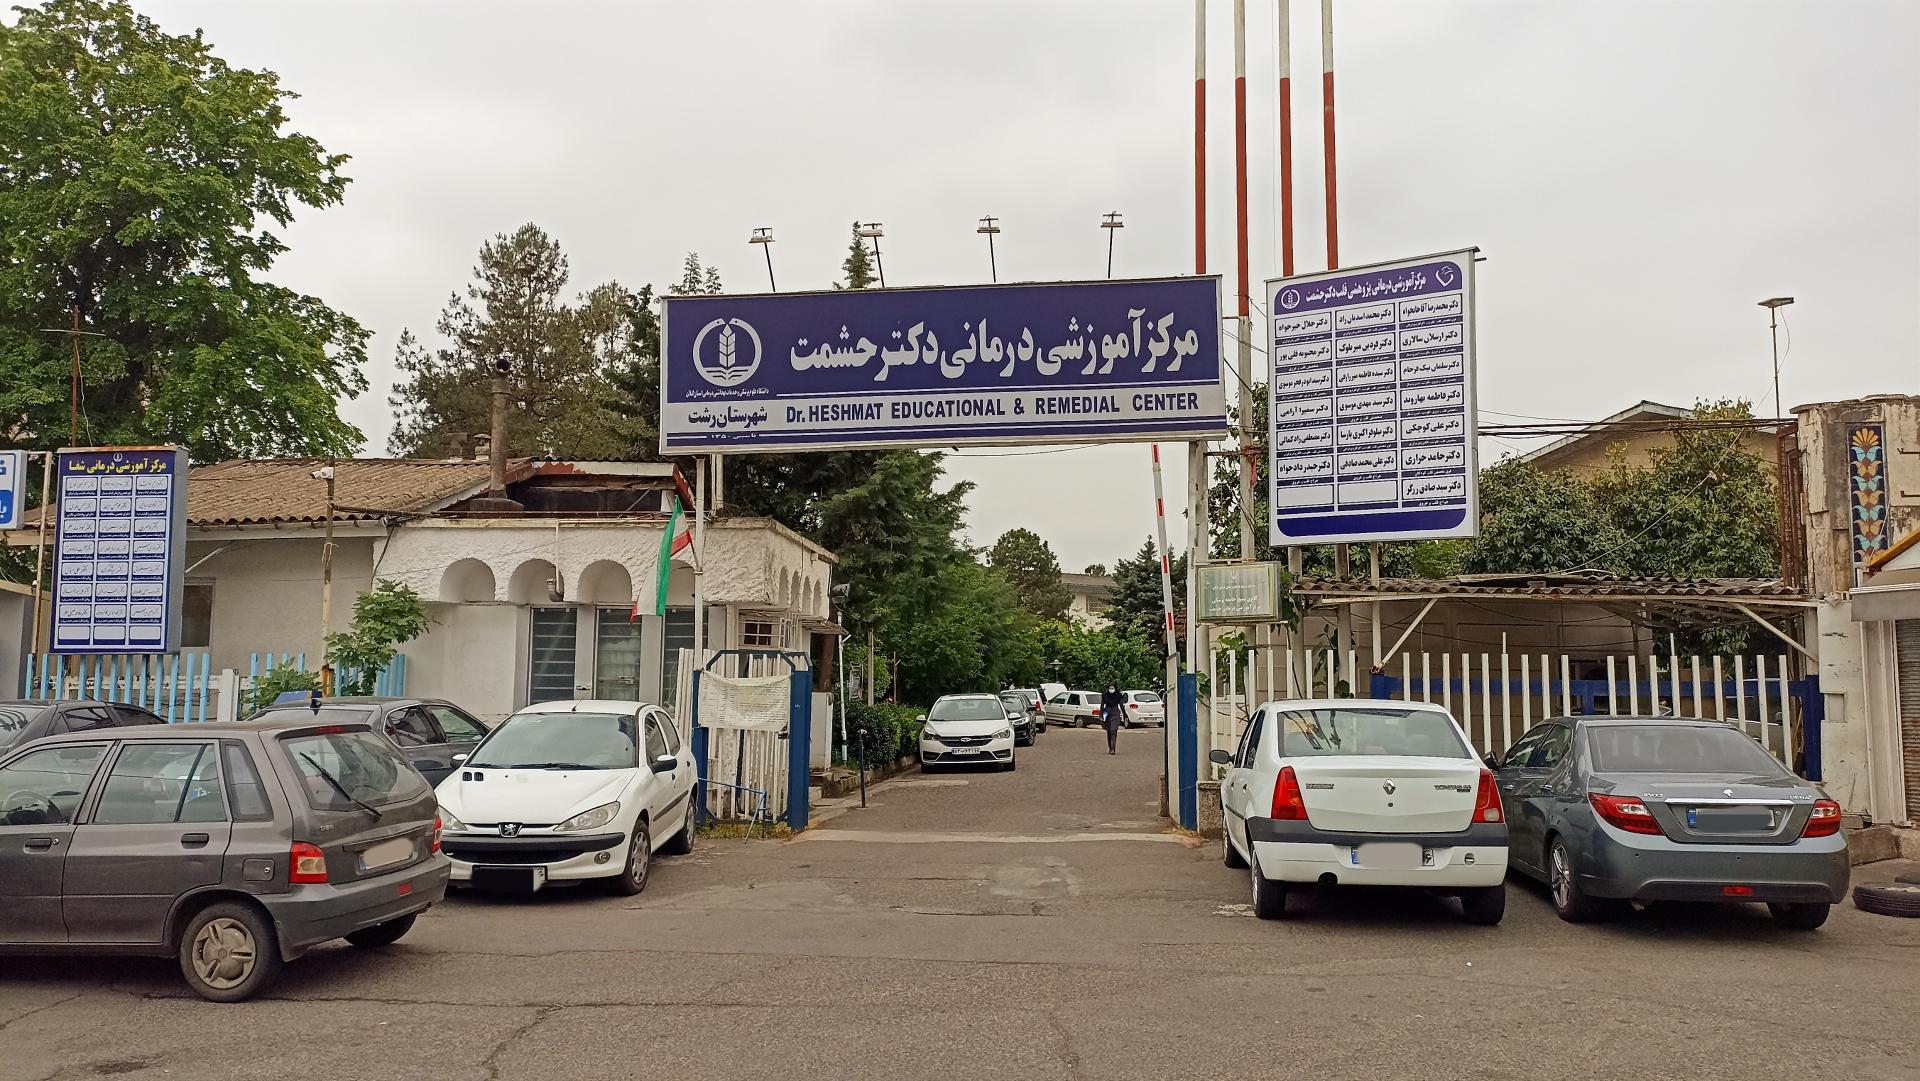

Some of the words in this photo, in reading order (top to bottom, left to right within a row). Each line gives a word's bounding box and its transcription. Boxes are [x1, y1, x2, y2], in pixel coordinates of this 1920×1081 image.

[790, 324, 878, 370] حشمت
[874, 321, 938, 382] دکتر
[940, 318, 1034, 379] درمانی
[1036, 308, 1146, 376] آموزشی
[1141, 312, 1198, 373] مرکز
[688, 407, 716, 428] رشت
[716, 406, 768, 428] شهرستان
[786, 406, 806, 423] Dr.
[808, 402, 884, 422] HESHMAT
[891, 396, 1006, 420] EDUCATIONAL
[1014, 398, 1024, 415] &
[1036, 395, 1120, 414] REMEDIAL
[1132, 392, 1199, 412] CENTER
[68, 460, 86, 471] شفا
[86, 459, 115, 474] درمانی
[116, 458, 148, 473] آموزشی
[148, 458, 166, 472] مرکز
